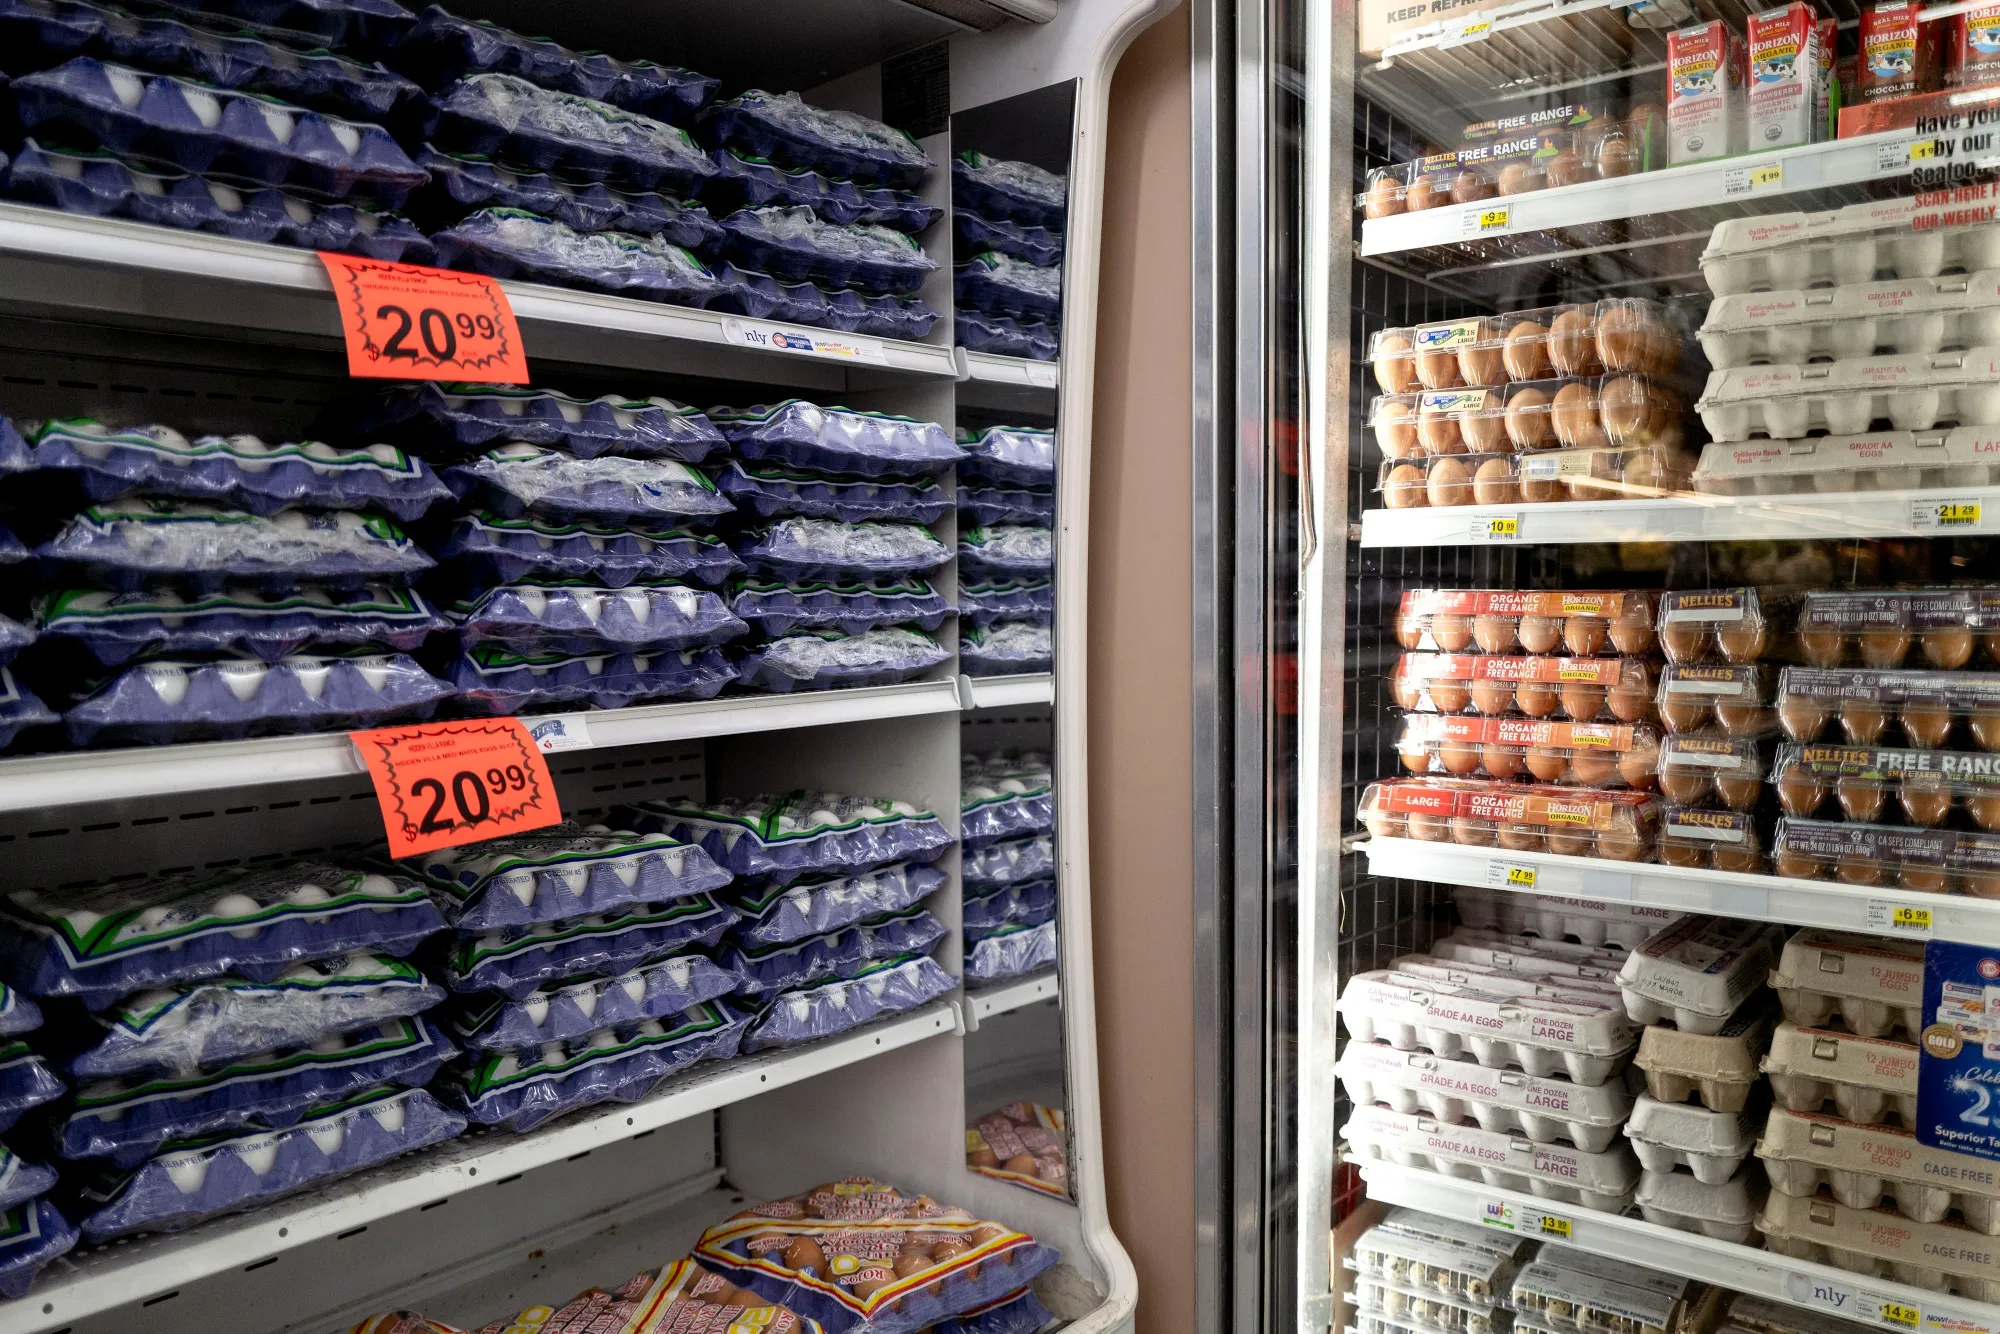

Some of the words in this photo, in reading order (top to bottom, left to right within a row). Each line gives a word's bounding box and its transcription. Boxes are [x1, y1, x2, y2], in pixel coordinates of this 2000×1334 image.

[1387, 5, 1426, 24] KEEP
[1750, 32, 1800, 55] HORIZON
[1865, 28, 1918, 48] HORIZON
[1753, 46, 1795, 61] ORGANIC
[1868, 40, 1913, 55] ORGANIC
[1670, 50, 1719, 71] HORIZON
[1674, 62, 1714, 76] ORGANIC
[1865, 82, 1915, 96] CHOCOLATE
[1498, 116, 1526, 129] FREE
[1531, 105, 1573, 123] RANGE
[1915, 112, 1960, 136] Have
[1424, 152, 1456, 165] NELLIES
[1458, 147, 1489, 162] FREE
[1493, 137, 1537, 154] RANGE
[1934, 138, 1955, 158] by
[1962, 133, 1994, 153] our
[1761, 174, 1767, 182] 1
[1914, 189, 1950, 209] SCAN
[1954, 184, 1988, 204] HERE
[1497, 211, 1507, 219] 79
[1912, 213, 1938, 231] OUR
[1943, 204, 1996, 227] WEEKLY
[390, 285, 411, 293] VILLA
[429, 288, 450, 297] WHITE
[451, 291, 470, 299] EGGS
[1867, 292, 1898, 301] GRADE
[1899, 290, 1913, 298] AA
[1878, 299, 1903, 307] EGGS
[1862, 366, 1892, 375] GRADE
[1893, 365, 1907, 374] AA
[1872, 373, 1897, 381] EGGS
[1849, 442, 1879, 451] GRADE
[1880, 441, 1893, 450] AA
[1859, 450, 1883, 458] EGGS
[1490, 594, 1540, 604] ORGANIC
[1562, 595, 1604, 605] HORIZON
[1678, 594, 1733, 609] NELLIES
[1913, 601, 1928, 610] SEFS
[1489, 603, 1509, 612] FREE
[1510, 604, 1538, 612] RANGE
[1487, 660, 1537, 670] ORGANIC
[1559, 662, 1601, 673] HORIZON
[1487, 669, 1507, 677] FREE
[1508, 669, 1535, 679] RANGE
[1678, 668, 1733, 681] NELLIES
[1499, 722, 1549, 733] ORGANIC
[1571, 726, 1613, 738] HORIZON
[408, 741, 427, 752] HIDDEN
[427, 742, 440, 752] VILLA
[439, 739, 456, 749] RANCH
[1498, 732, 1518, 742] FREE
[1519, 733, 1547, 742] RANGE
[1574, 737, 1609, 745] ORGANIC
[1678, 739, 1733, 754] NELLIES
[395, 757, 422, 768] HIDDEN
[422, 754, 441, 764] VILLA
[442, 752, 457, 761] MED
[458, 748, 478, 758] WHITE
[479, 745, 498, 754] EGGS
[1802, 749, 1869, 765] NELLIES
[1876, 752, 1931, 770] FREE
[495, 805, 511, 816] Each
[1406, 795, 1440, 807] LARGE
[1472, 796, 1525, 808] ORGANIC
[1547, 802, 1591, 817] HORIZON
[1471, 806, 1492, 816] FREE
[1550, 814, 1587, 823] ORGANIC
[1678, 812, 1733, 828] NELLIES
[1878, 836, 1887, 845] CA
[1888, 837, 1903, 847] SEFS
[1905, 838, 1943, 850] COMPLIANT
[1580, 900, 1606, 912] EGGS
[1631, 906, 1670, 919] LARGE
[1916, 911, 1928, 919] 99
[1870, 966, 1882, 976] 12
[1883, 969, 1920, 984] JUMBO
[1879, 977, 1909, 992] EGGS
[1427, 1005, 1459, 1021] GRADE
[1461, 1012, 1474, 1024] AA
[1474, 1015, 1504, 1029] EGGS
[1533, 1016, 1549, 1027] ONE
[1550, 1019, 1574, 1030] DOZEN
[1531, 1026, 1574, 1042] LARGE
[1928, 1034, 1956, 1049] GOLD
[1878, 1056, 1915, 1071] JUMBO
[1875, 1065, 1905, 1079] EGGS
[1420, 1073, 1452, 1089] GRADE
[1454, 1080, 1469, 1091] AA
[1470, 1082, 1498, 1097] EGGS
[1544, 1088, 1568, 1099] DOZEN
[1525, 1094, 1569, 1111] LARGE
[1935, 1125, 1985, 1144] Superior
[1428, 1137, 1460, 1152] GRADE
[1461, 1144, 1476, 1156] AA
[1477, 1147, 1506, 1162] EGGS
[1553, 1154, 1577, 1166] DOZEN
[1875, 1144, 1912, 1160] JUMBO
[1939, 1140, 1957, 1149] Better
[1975, 1147, 1994, 1156] Better
[1534, 1160, 1578, 1178] LARGE
[1871, 1153, 1901, 1168] EGGS
[1923, 1162, 1956, 1179] CAGE
[1961, 1169, 1993, 1185] FREE
[1487, 1200, 1513, 1219] wic
[1557, 1220, 1567, 1229] 99
[1874, 1223, 1912, 1239] JUMBO
[1871, 1234, 1901, 1248] EGGS
[1923, 1243, 1956, 1259] CAGE
[1960, 1249, 1991, 1265] FREE
[840, 1268, 886, 1285] ROJOS
[1904, 1310, 1915, 1319] 29
[1926, 1314, 1948, 1324] NOW!
